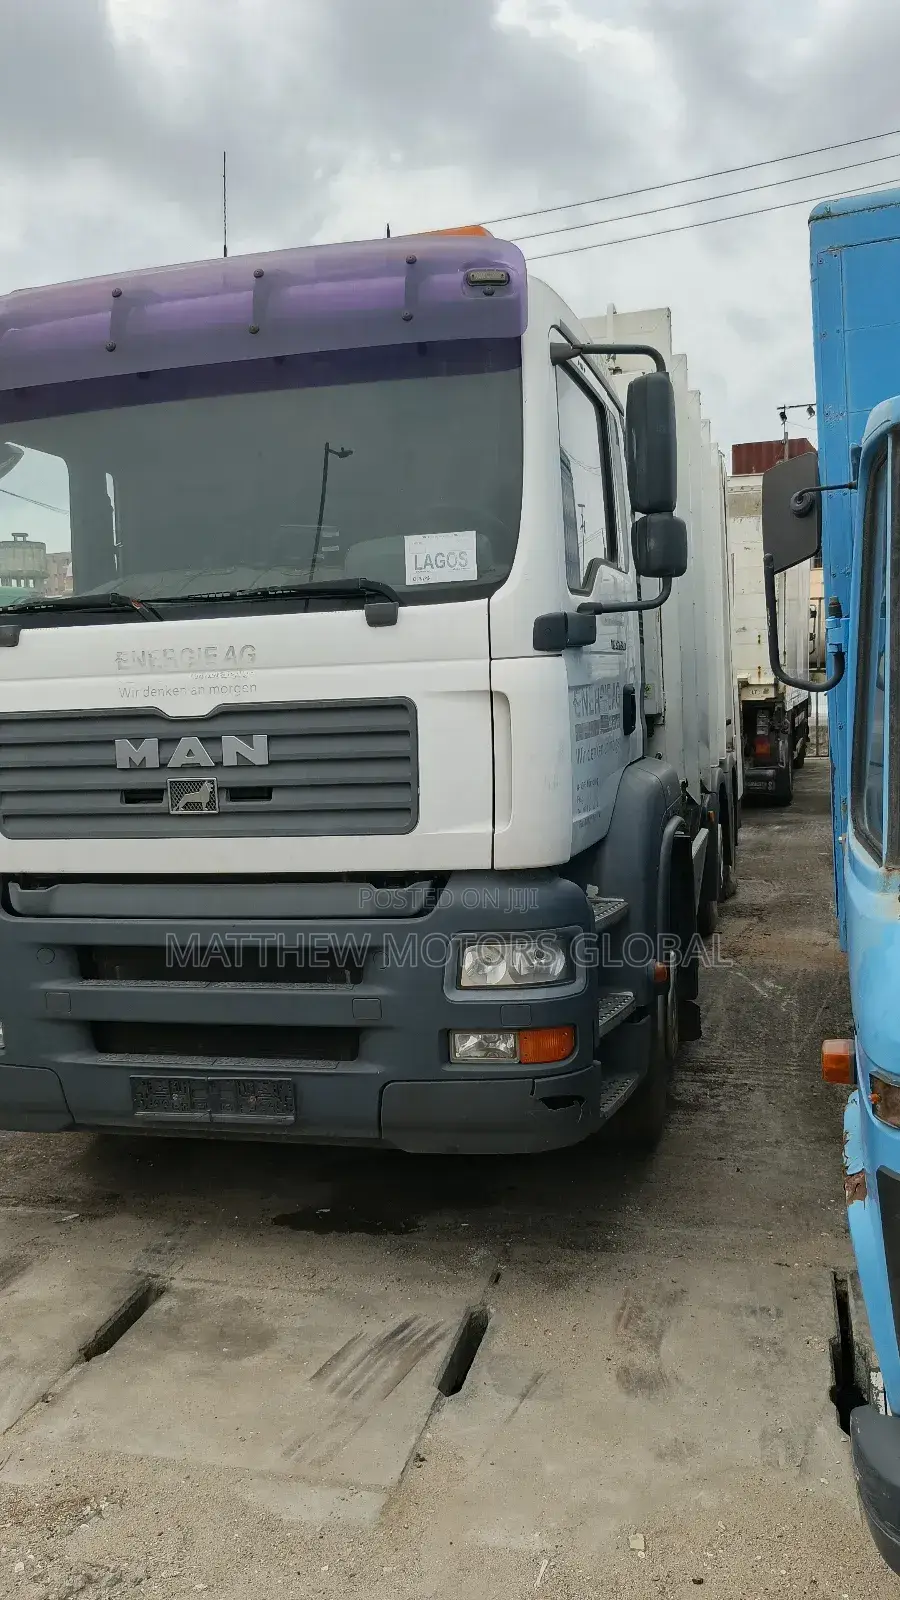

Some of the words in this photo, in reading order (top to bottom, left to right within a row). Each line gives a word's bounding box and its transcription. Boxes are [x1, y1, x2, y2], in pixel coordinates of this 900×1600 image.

[414, 551, 468, 571] LAGOS
[115, 646, 218, 671] ENERGIE
[224, 644, 257, 665] AG
[119, 686, 139, 699] Wir
[143, 684, 187, 698] denken
[191, 685, 205, 696] an
[209, 682, 257, 697] morgen
[115, 734, 269, 769] MAN
